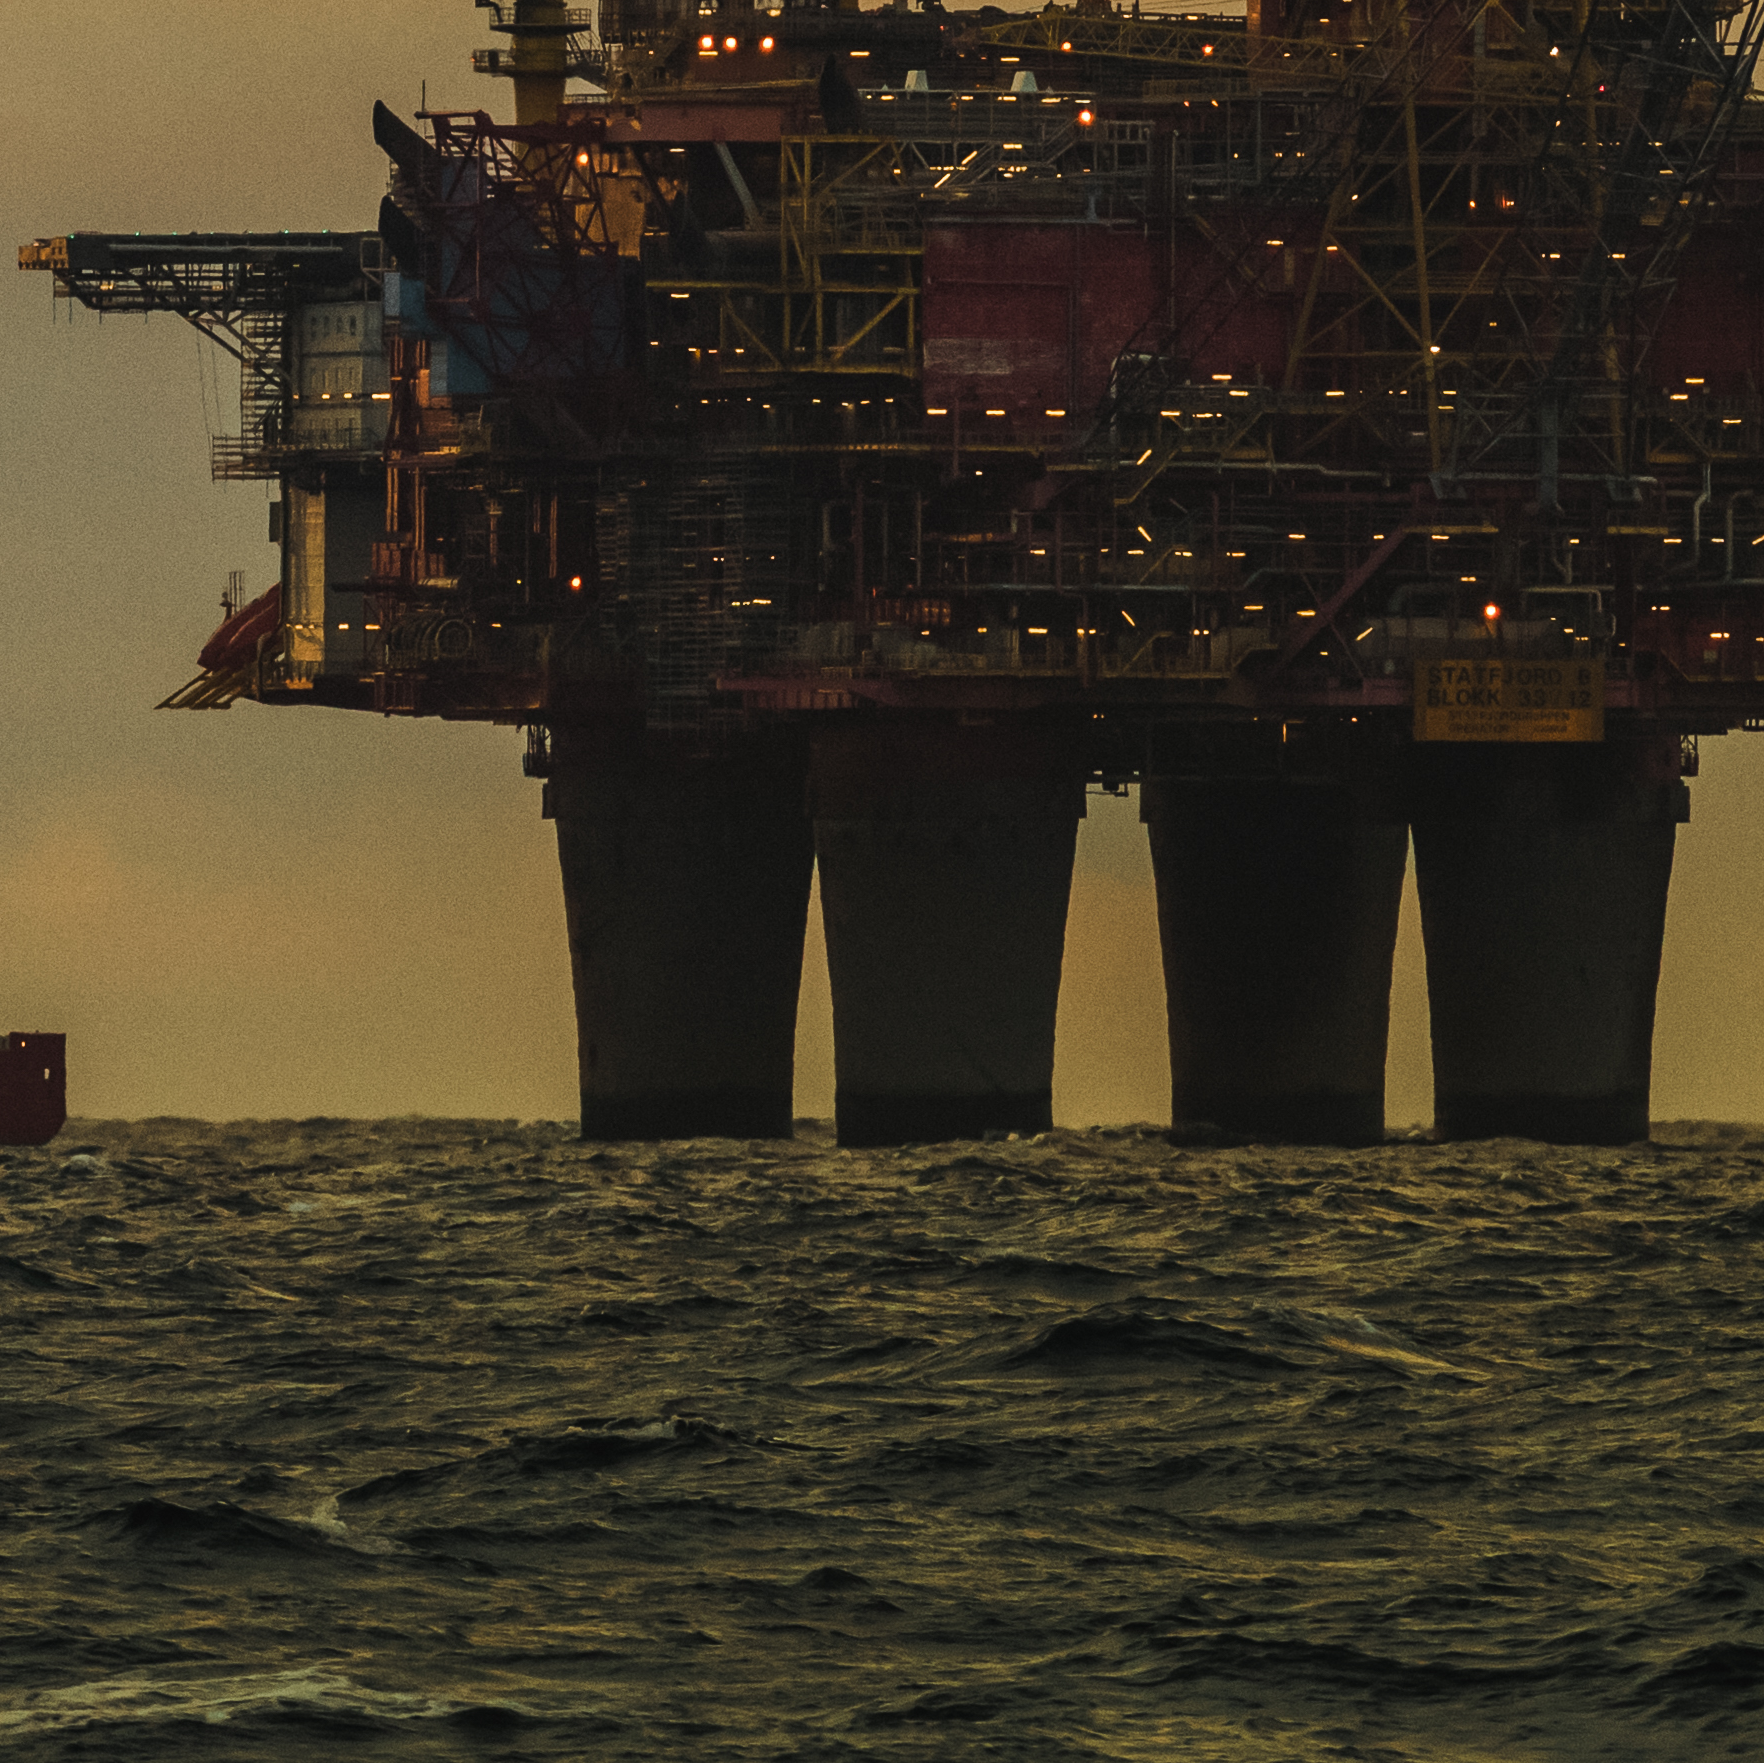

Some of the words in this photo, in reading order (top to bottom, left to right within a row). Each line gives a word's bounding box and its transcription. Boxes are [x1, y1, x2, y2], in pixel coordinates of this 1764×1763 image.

[1428, 667, 1562, 685] STATFJORD
[1577, 667, 1591, 684] B
[1426, 689, 1501, 707] BLOKK
